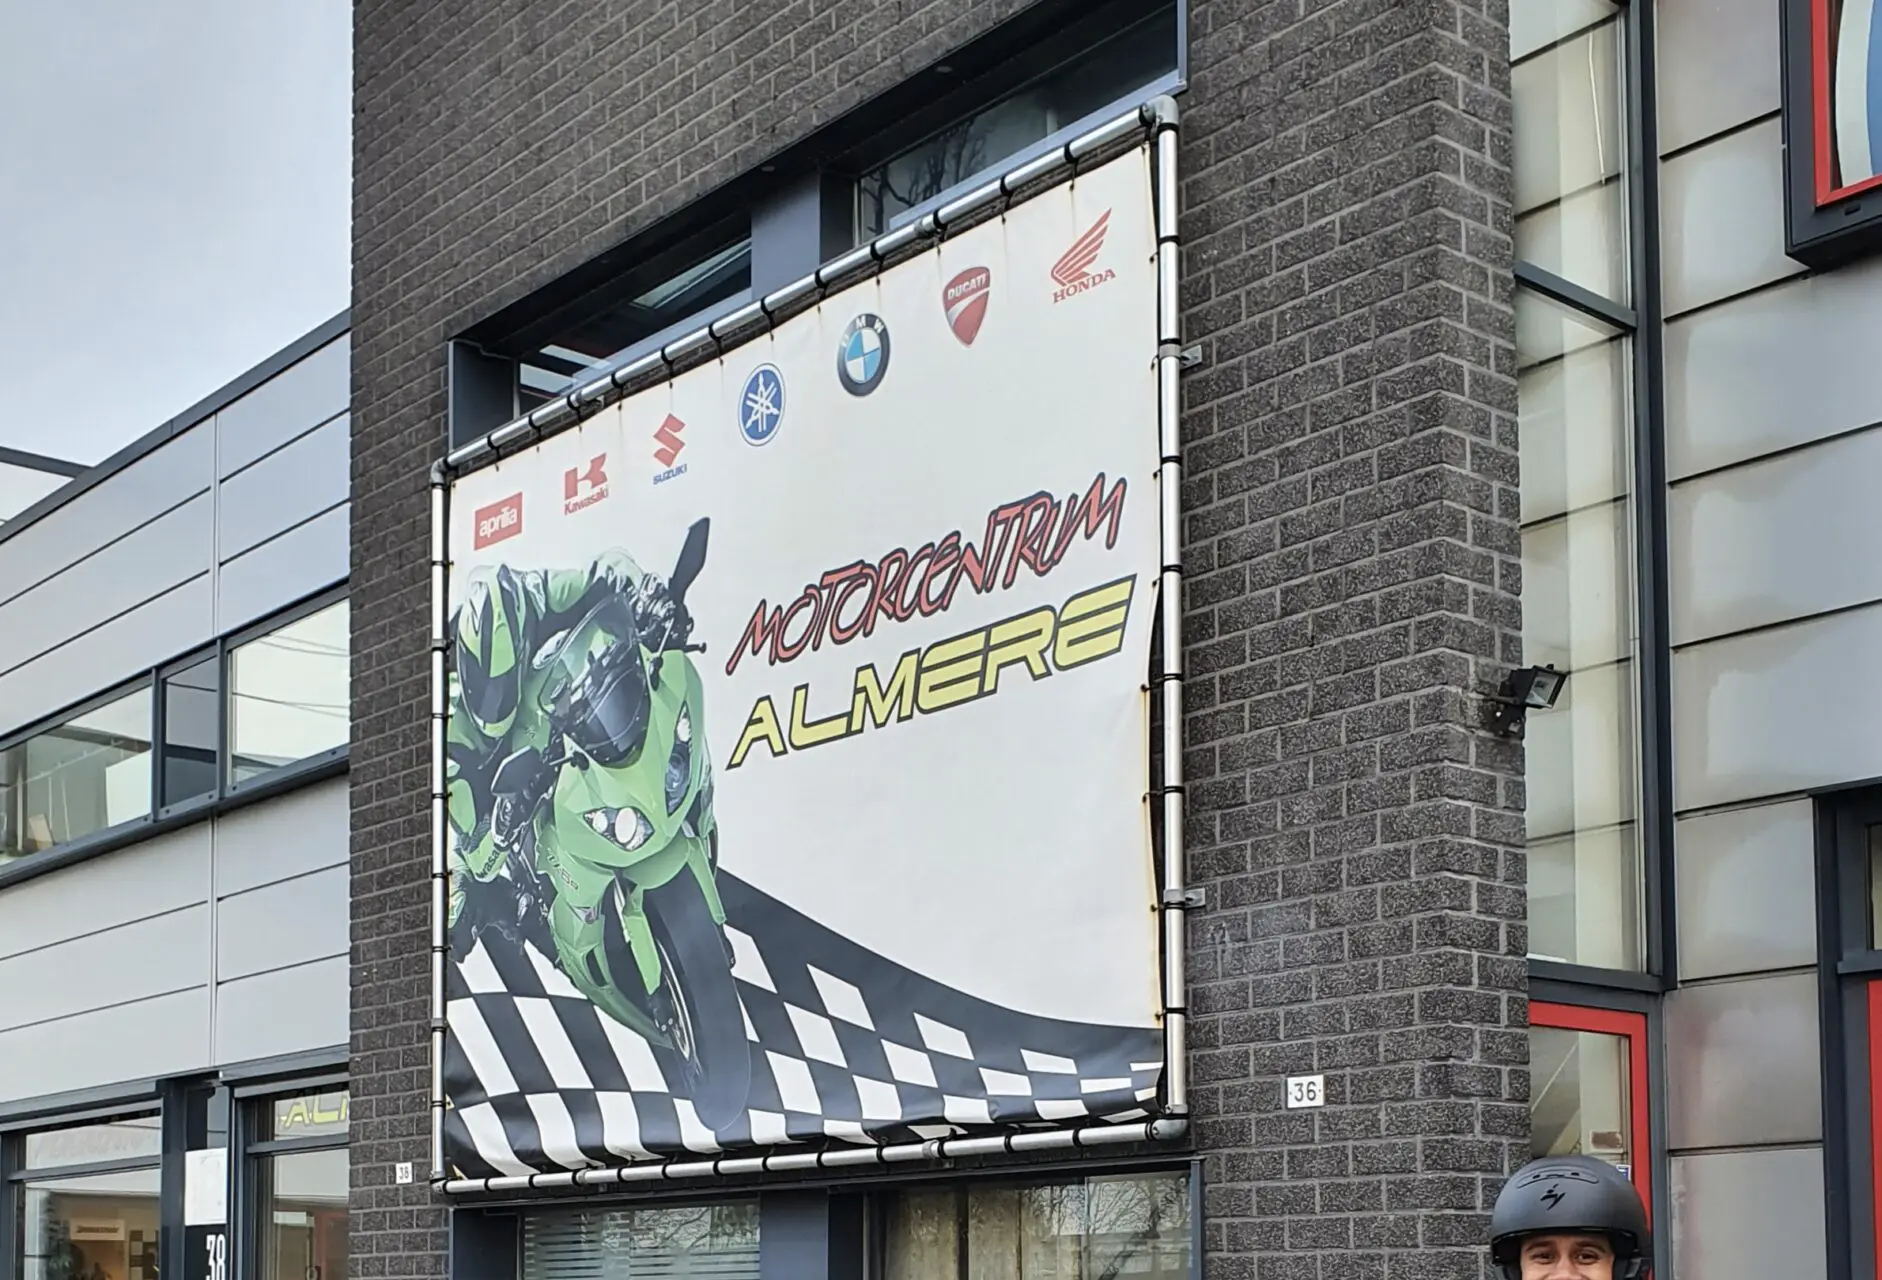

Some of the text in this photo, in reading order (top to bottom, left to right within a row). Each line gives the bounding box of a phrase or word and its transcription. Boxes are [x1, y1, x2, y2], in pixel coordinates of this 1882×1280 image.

[947, 273, 988, 301] DUCATI
[1052, 268, 1117, 304] HONDA
[653, 463, 688, 485] SUZUKI
[564, 485, 609, 516] Kawasaki
[478, 505, 518, 539] aprilia
[725, 471, 1128, 676] MOTORCENTRUM
[725, 573, 1138, 770] ALMERE
[1293, 1081, 1317, 1102] 36
